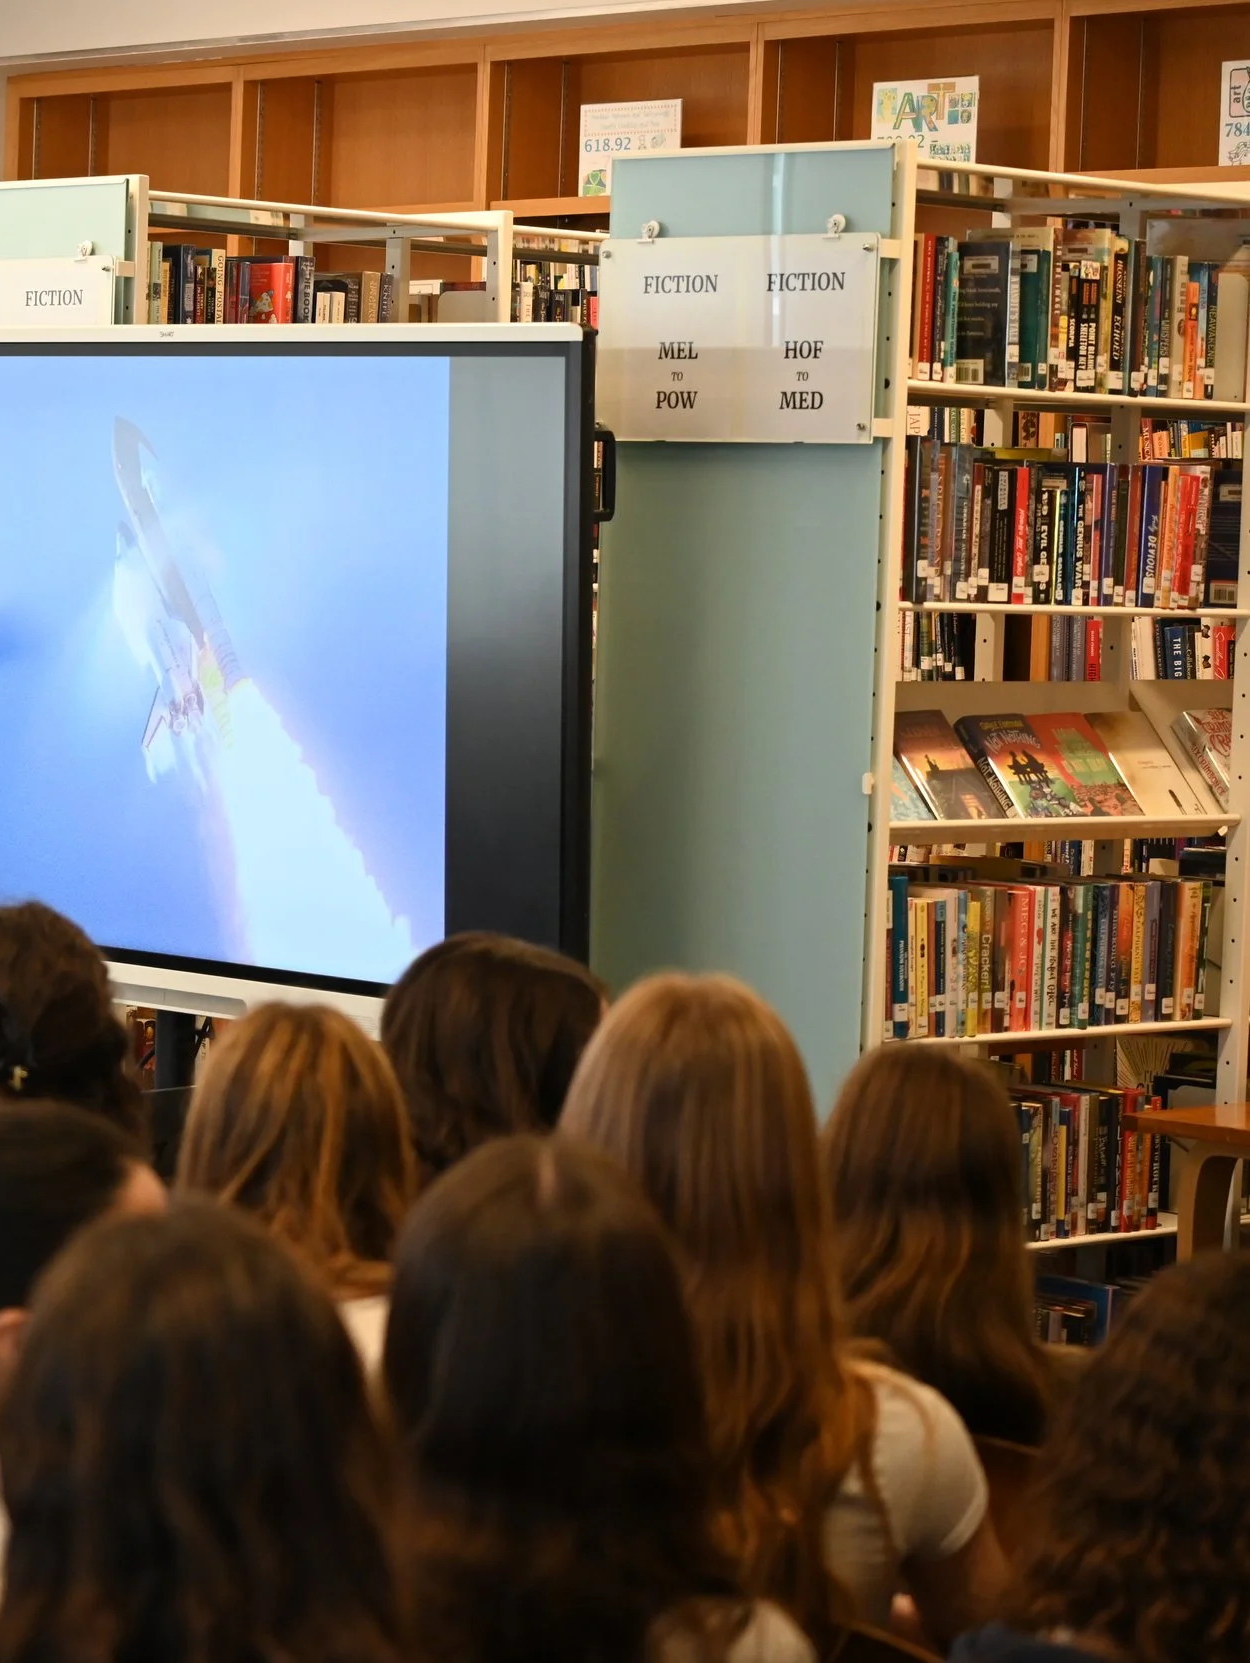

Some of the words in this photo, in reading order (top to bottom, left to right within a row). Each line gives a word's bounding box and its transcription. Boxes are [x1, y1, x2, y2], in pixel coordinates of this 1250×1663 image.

[584, 137, 631, 153] 618.92
[643, 274, 719, 294] FICTION
[766, 271, 846, 292] FICTION
[1116, 259, 1124, 303] HOSSEINI
[25, 289, 84, 307] FICTION
[216, 290, 224, 323] POSTAL
[303, 292, 311, 321] BOOK
[1068, 318, 1076, 347] SCORPIA
[1079, 323, 1089, 355] SKELETON
[1088, 322, 1096, 345] POINT
[1113, 315, 1122, 360] ECHOED
[1160, 319, 1170, 356] WHISPERS
[658, 341, 699, 360] MEL
[784, 340, 824, 360] HOF
[1079, 356, 1088, 370] KEY
[671, 371, 684, 382] TO
[796, 371, 809, 382] TO
[655, 391, 698, 410] POW
[779, 391, 824, 410] MED
[1040, 524, 1048, 549] EVIL
[1075, 520, 1084, 558] GENIUS
[1145, 535, 1157, 578] DEVIOUS
[1039, 551, 1048, 590] GES
[1173, 637, 1181, 656] THE
[1174, 660, 1182, 677] BIG
[987, 775, 1014, 811] NOTHING
[1020, 897, 1029, 933] MEG
[1051, 908, 1057, 920] WE
[1110, 908, 1118, 968] Blackbird
[980, 933, 992, 989] Cracker!
